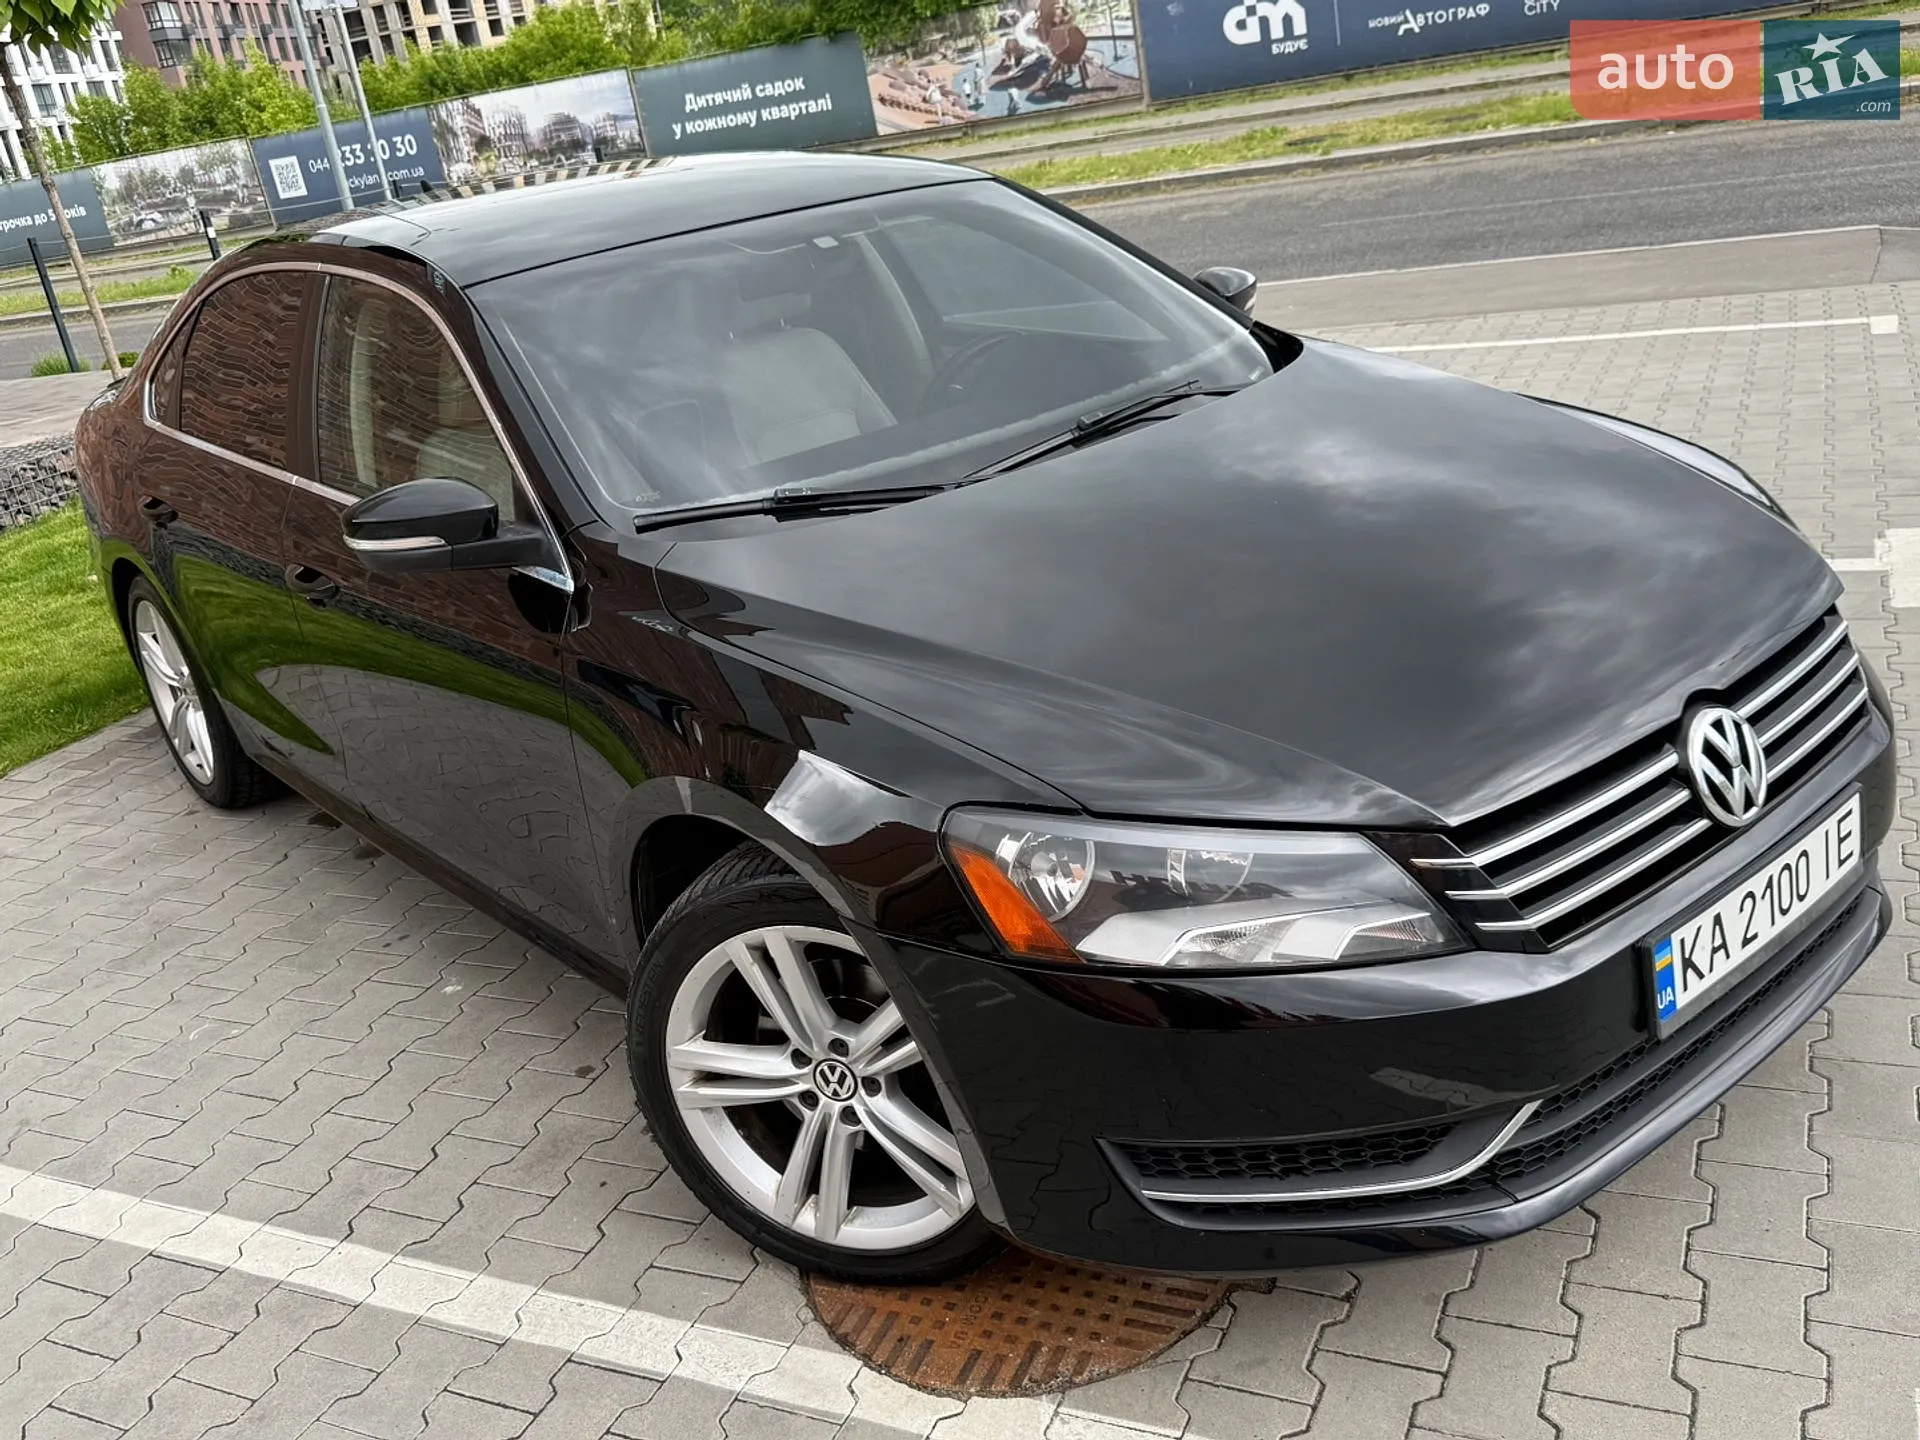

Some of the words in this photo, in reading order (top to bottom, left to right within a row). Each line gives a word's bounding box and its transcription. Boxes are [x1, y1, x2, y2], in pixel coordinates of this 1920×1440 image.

[1523, 0, 1560, 16] CITY
[684, 83, 752, 113] Дитячий
[755, 76, 806, 97] садок
[672, 122, 682, 140] у
[685, 110, 758, 134] кожному
[761, 93, 833, 120] кварталі
[308, 157, 330, 174] 044
[392, 133, 418, 158] 30
[33, 213, 48, 226] до
[63, 203, 87, 219] оків
[1678, 912, 1731, 993] KA
[1739, 849, 1810, 950] 2100
[1825, 807, 1855, 881] IE
[1656, 985, 1676, 1010] UA
